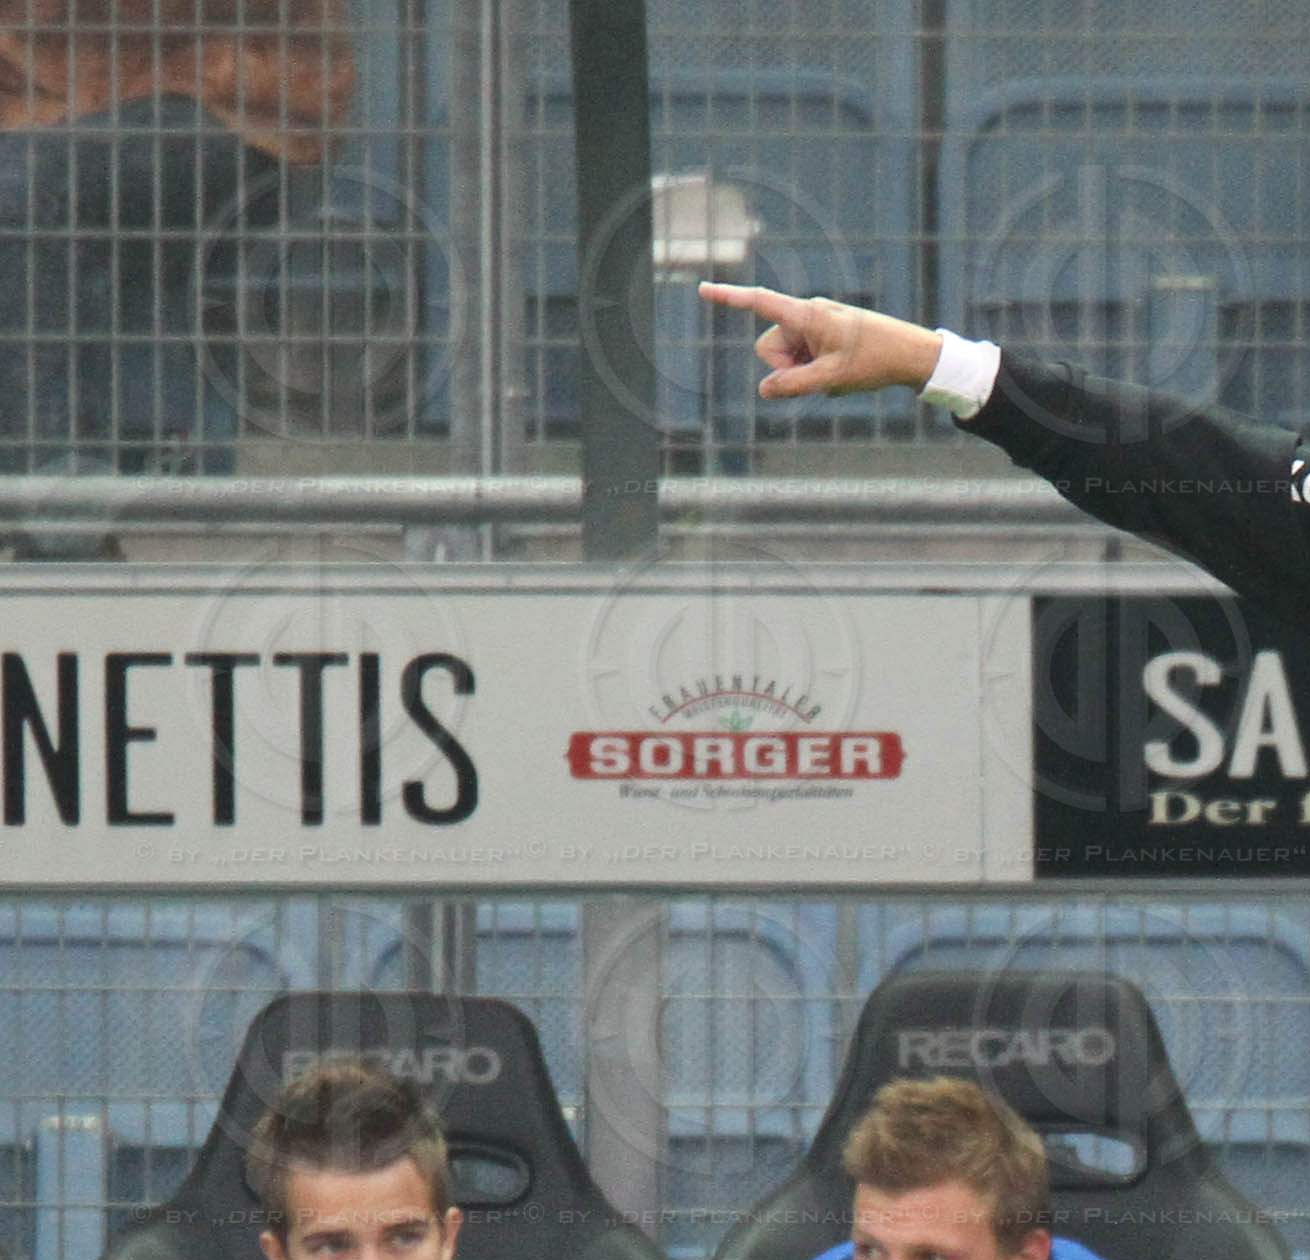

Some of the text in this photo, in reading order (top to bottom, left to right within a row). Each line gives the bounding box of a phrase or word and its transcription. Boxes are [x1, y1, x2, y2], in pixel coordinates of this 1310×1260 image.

[2, 652, 479, 828] NETTIS
[589, 735, 884, 775] SORGER
[1148, 789, 1278, 827] Der
[898, 1028, 1116, 1068] RECARO
